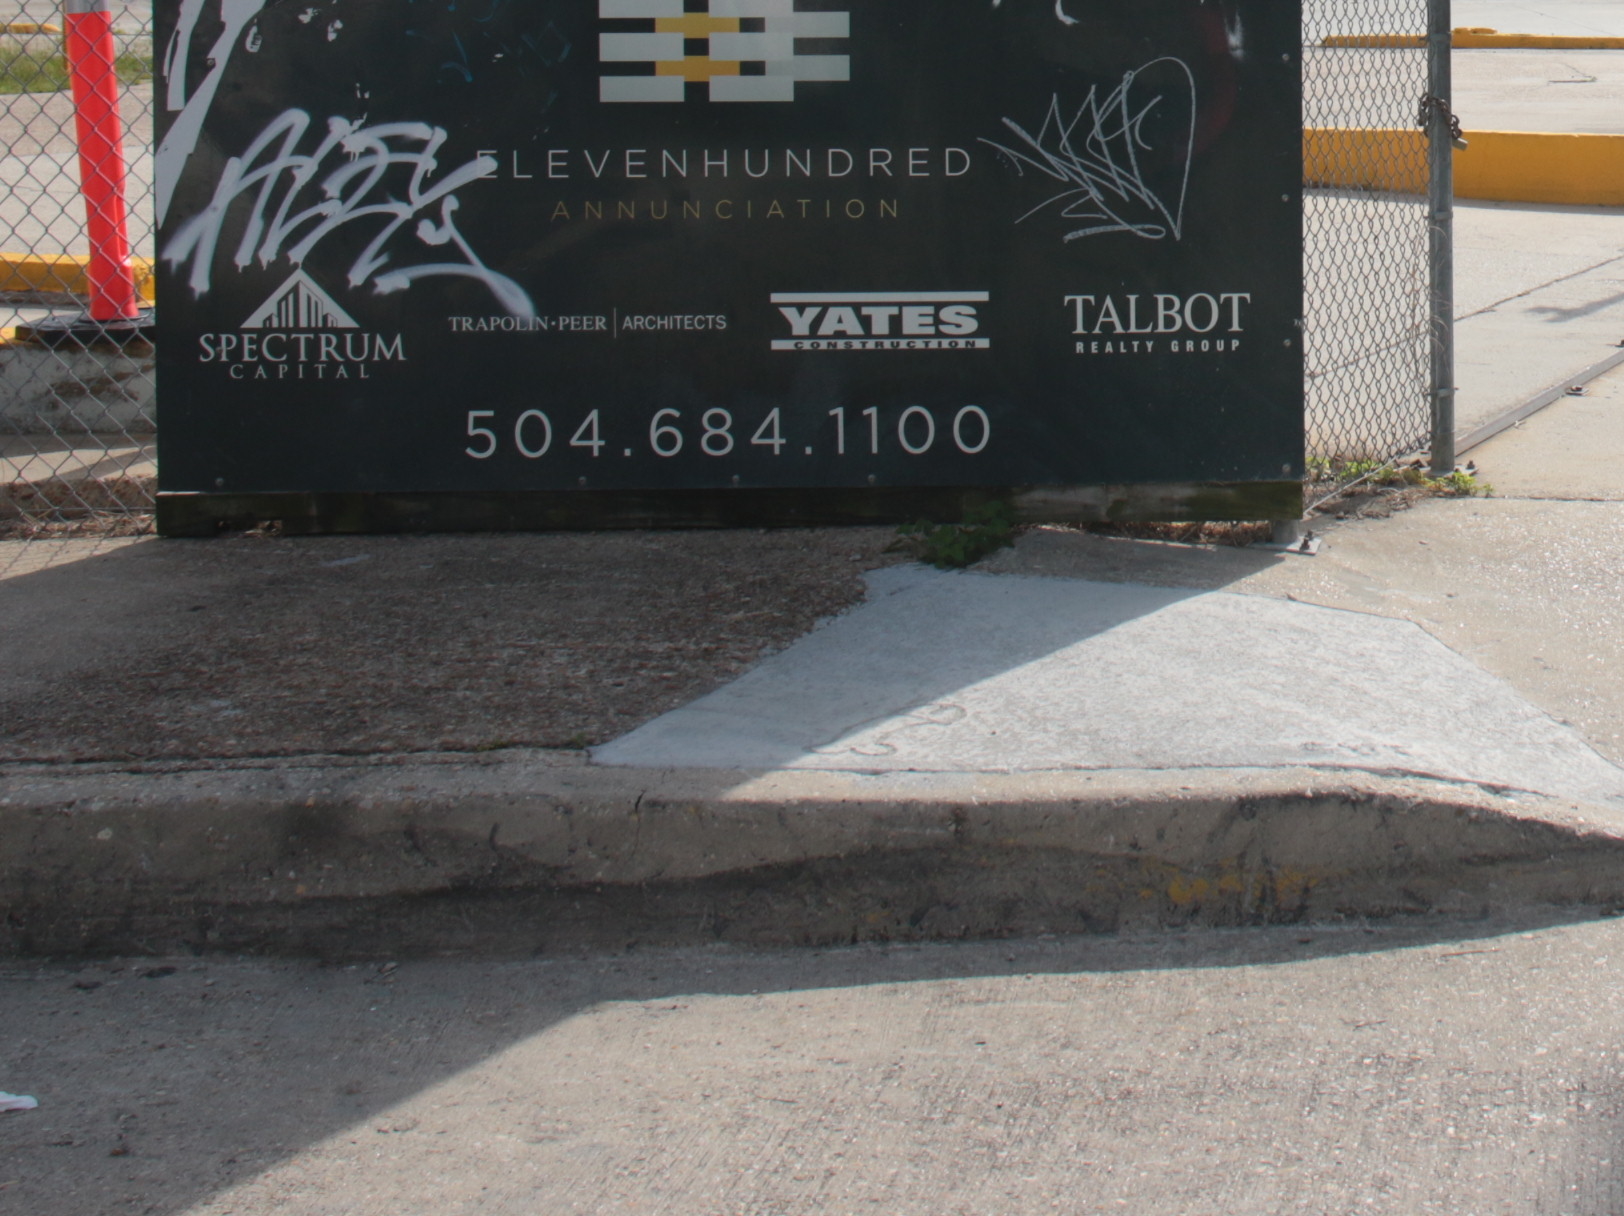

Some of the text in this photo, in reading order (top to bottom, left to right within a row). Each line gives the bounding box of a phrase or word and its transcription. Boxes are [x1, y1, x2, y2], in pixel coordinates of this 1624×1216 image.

[551, 199, 898, 221] ANNUNCIATION
[622, 314, 727, 330] ARCHITECTS
[778, 305, 979, 335] YATES
[1064, 293, 1251, 334] TALBOT
[199, 333, 407, 362] SPECTRUM
[793, 339, 976, 350] CONSTRUCTION
[1075, 339, 1240, 354] REALTY GROUP
[229, 364, 370, 379] CAPITAL
[465, 404, 990, 459] 504.684.1100
